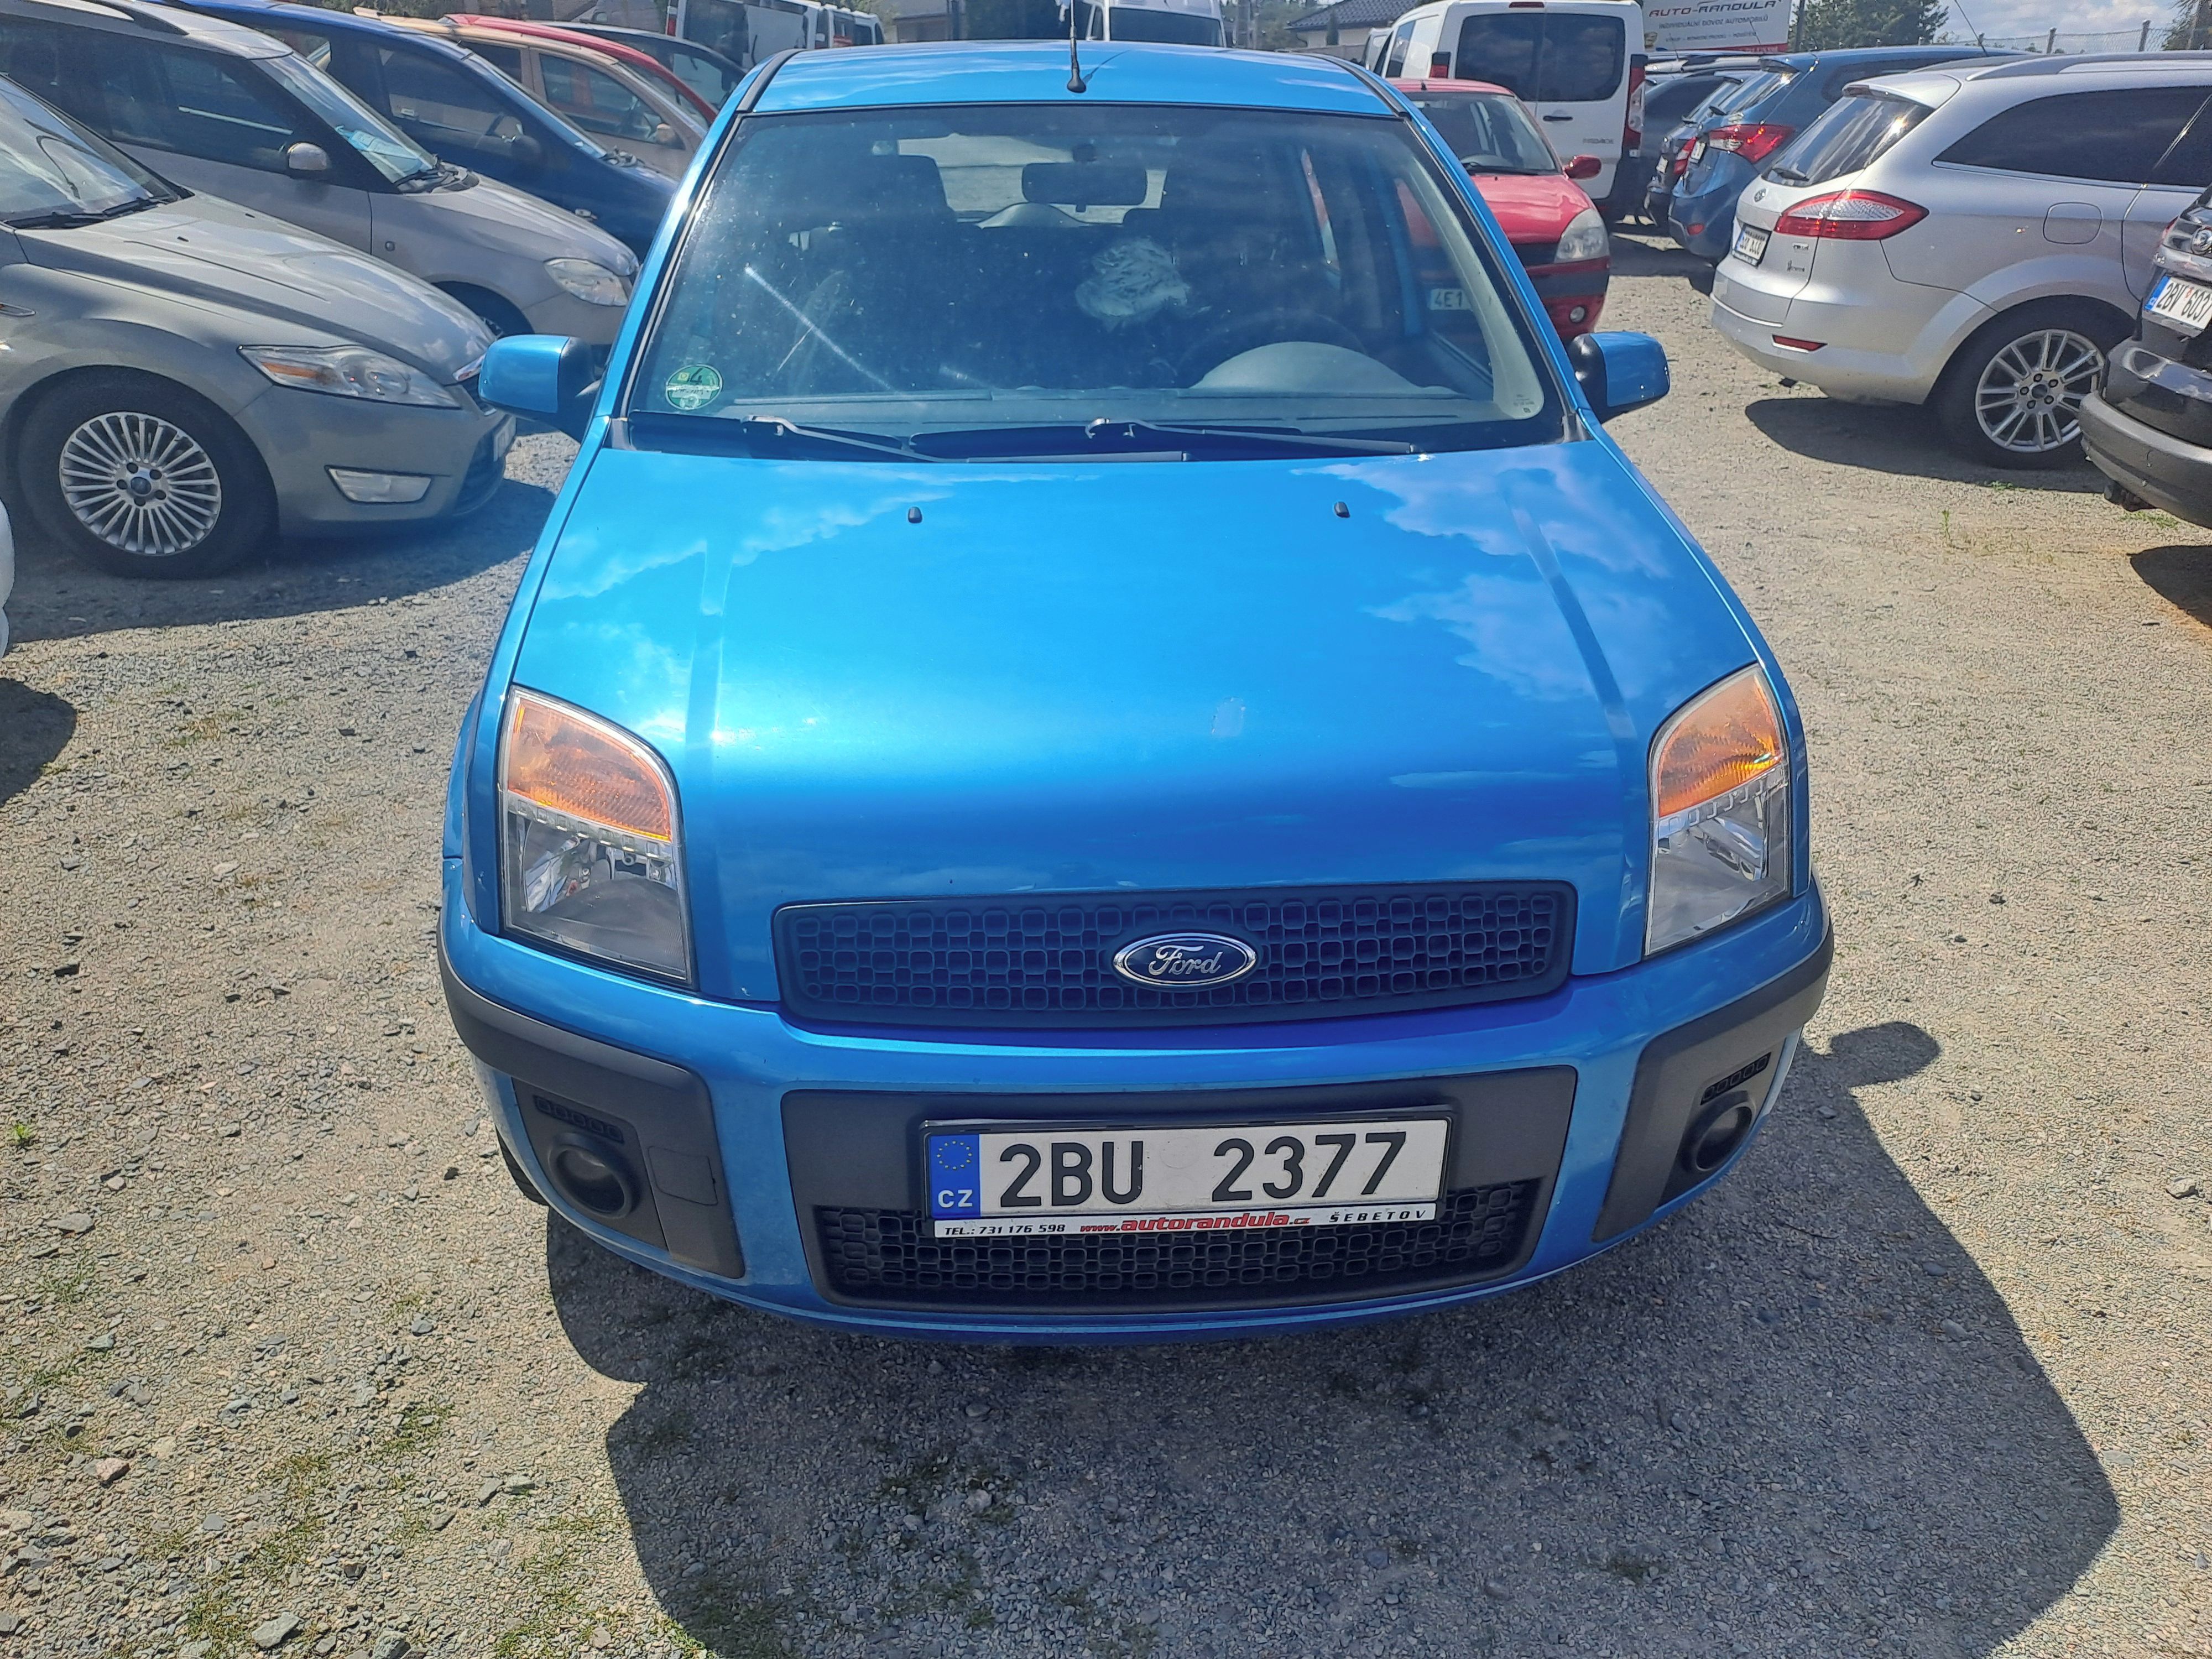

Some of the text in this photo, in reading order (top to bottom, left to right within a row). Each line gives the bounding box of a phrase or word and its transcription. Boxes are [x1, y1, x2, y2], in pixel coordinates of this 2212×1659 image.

[1649, 1, 1776, 18] AUTO-RANDULA
[1149, 945, 1223, 975] Ford
[999, 1131, 1406, 1208] 2BU 2377
[938, 1189, 973, 1208] CZ
[979, 1226, 1003, 1234] 731
[1008, 1225, 1034, 1233] 176
[1037, 1224, 1066, 1233] 598
[1080, 1212, 1311, 1232] www.autorandula.cz
[1329, 1210, 1426, 1223] ŠEBETOV
